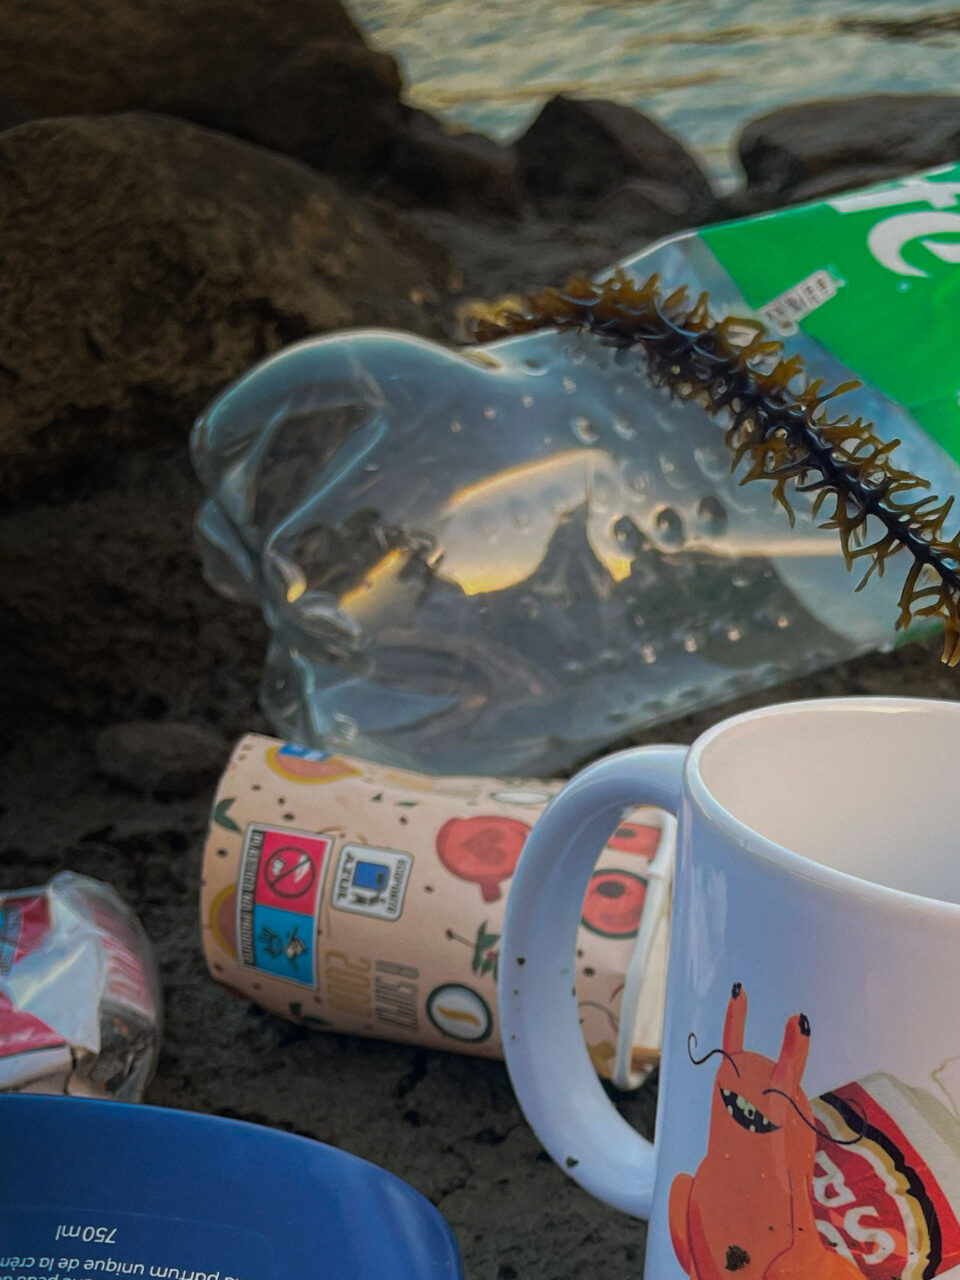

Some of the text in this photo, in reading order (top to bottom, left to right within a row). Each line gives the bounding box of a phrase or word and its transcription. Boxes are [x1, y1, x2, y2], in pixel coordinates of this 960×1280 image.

[39, 1257, 54, 1270] la
[58, 1257, 80, 1272] de
[84, 1258, 145, 1276] unique
